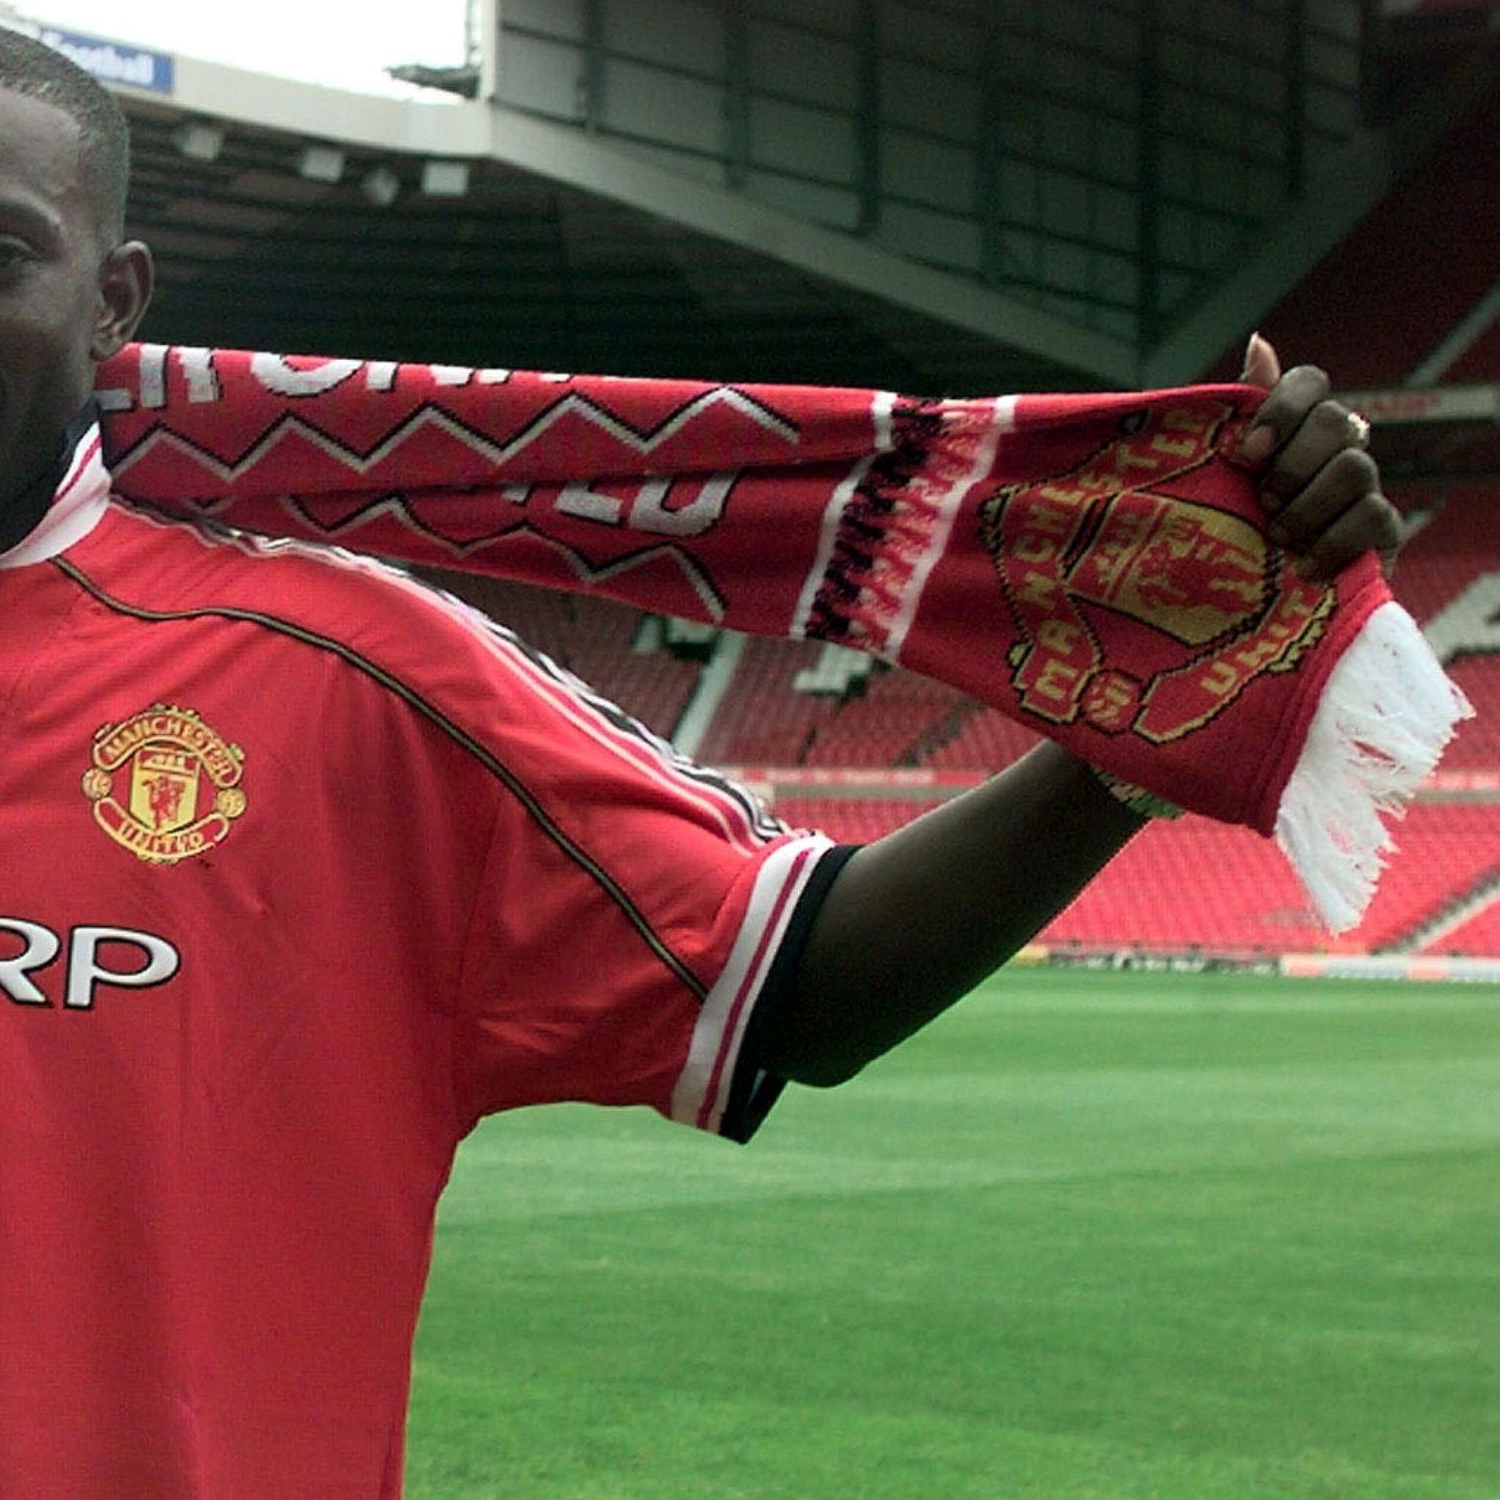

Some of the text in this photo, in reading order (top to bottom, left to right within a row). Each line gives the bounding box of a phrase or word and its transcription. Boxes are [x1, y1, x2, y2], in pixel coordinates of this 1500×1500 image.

[1201, 568, 1312, 694] UNIT
[104, 716, 233, 776] MANCHESTER
[120, 822, 204, 853] UNITED
